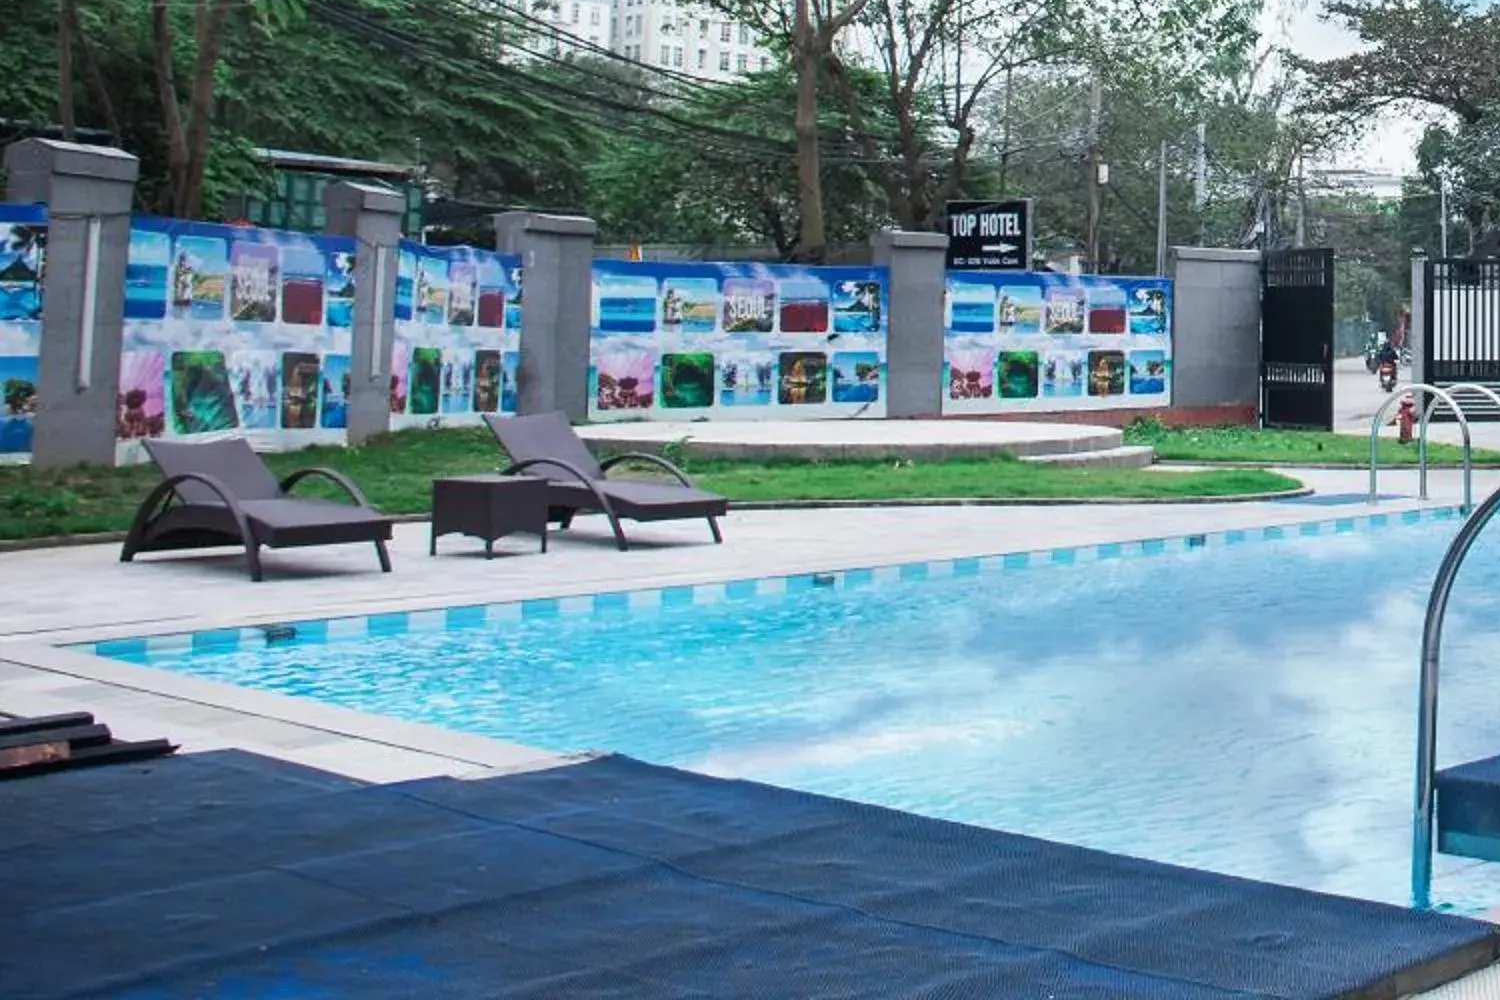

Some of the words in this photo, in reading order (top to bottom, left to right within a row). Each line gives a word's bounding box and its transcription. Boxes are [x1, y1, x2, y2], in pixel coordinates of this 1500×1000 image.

[951, 214, 977, 237] TOP
[980, 213, 1021, 237] HOTEL
[729, 295, 768, 319] SEOUL
